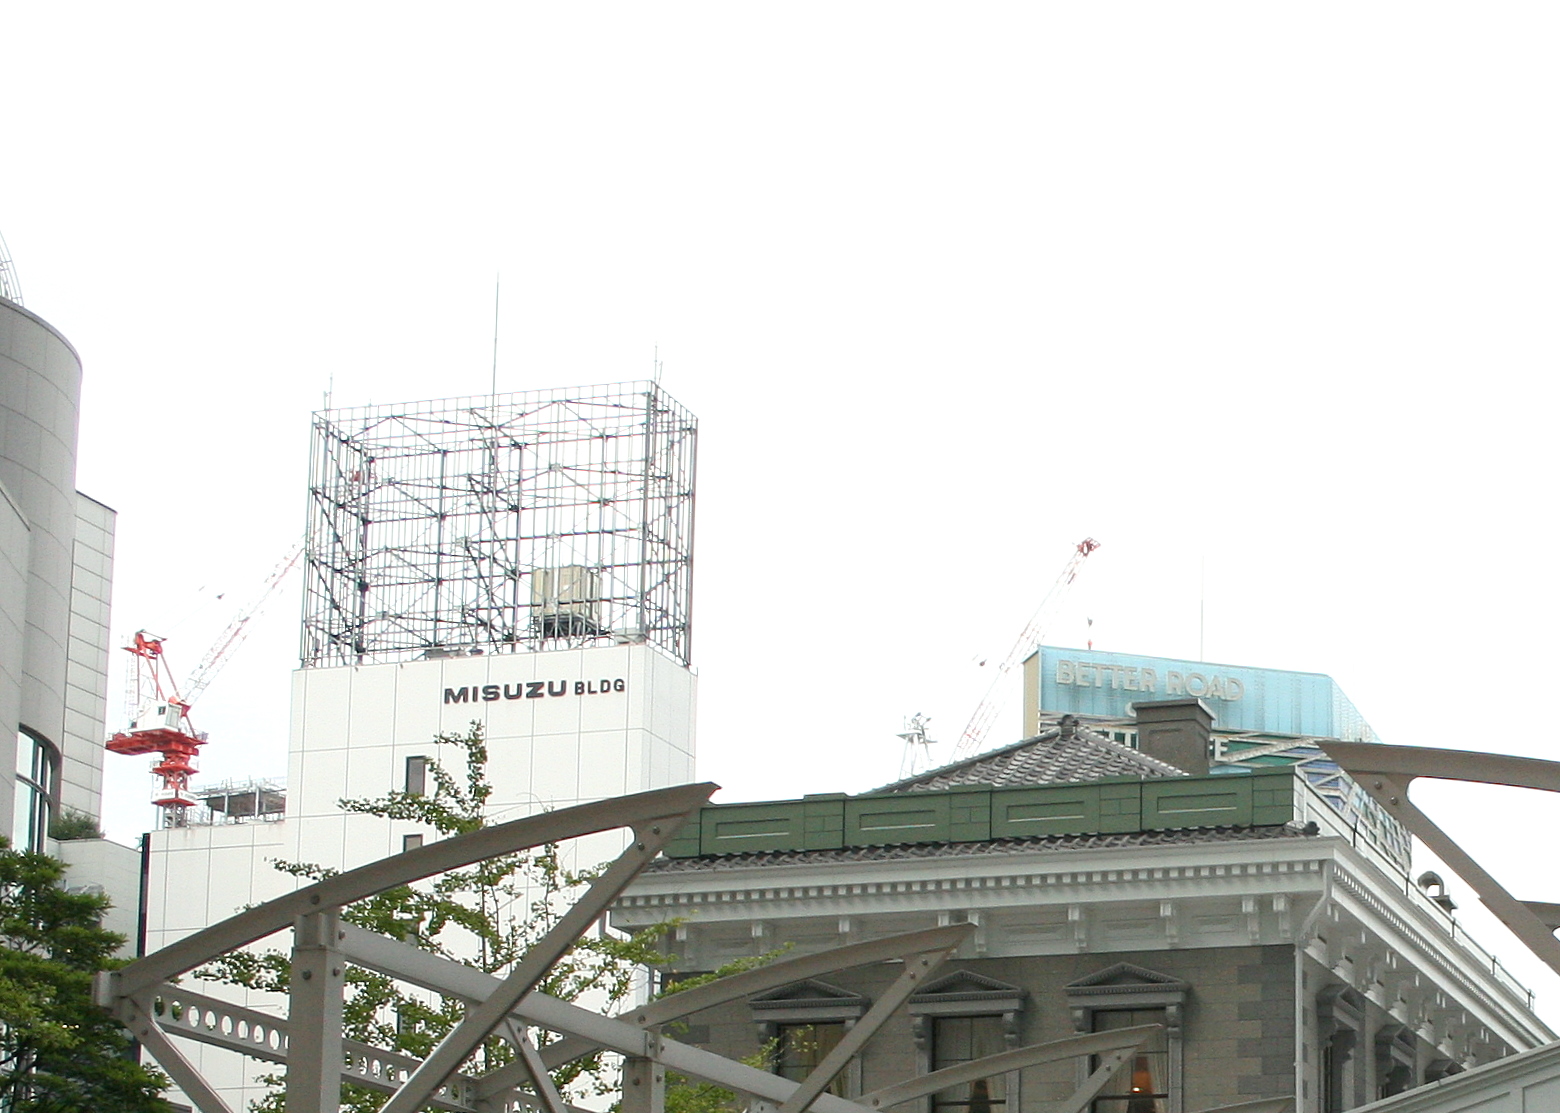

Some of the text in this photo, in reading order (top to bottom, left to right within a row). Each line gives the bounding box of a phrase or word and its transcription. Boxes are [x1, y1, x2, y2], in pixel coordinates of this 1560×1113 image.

[444, 678, 626, 704] MISUZU BLDG
[1056, 660, 1245, 701] BETTER ROAD
